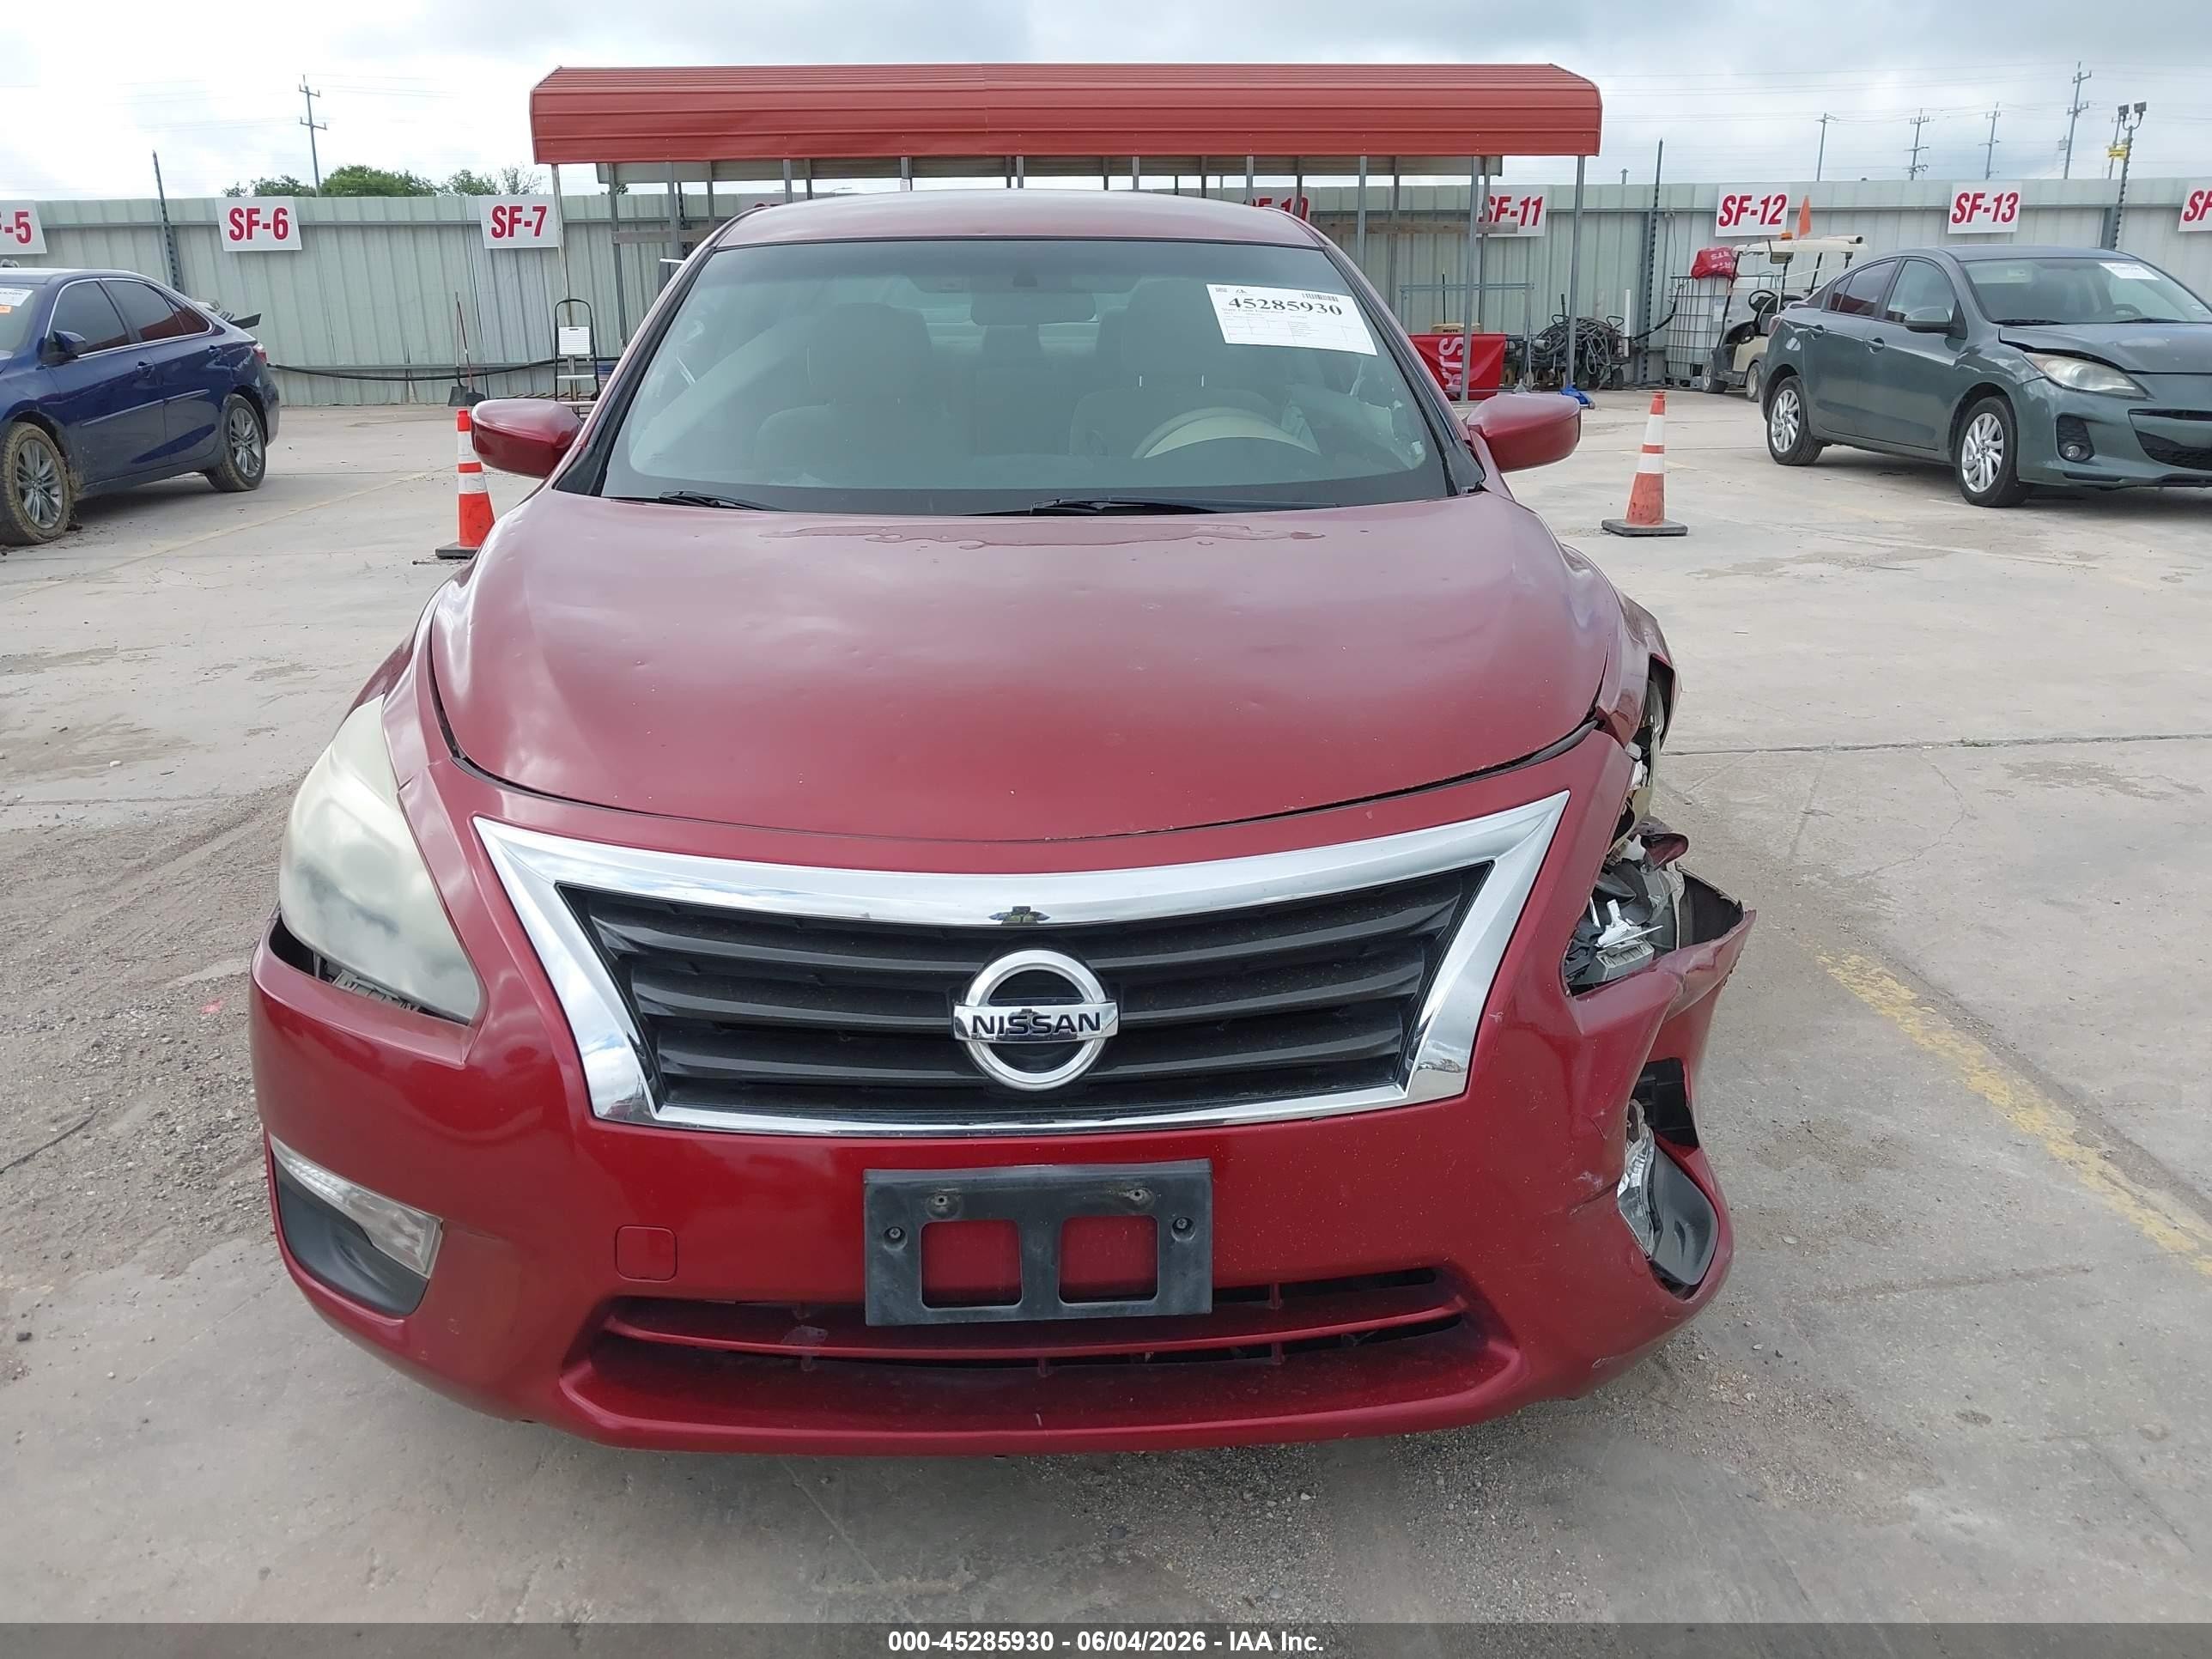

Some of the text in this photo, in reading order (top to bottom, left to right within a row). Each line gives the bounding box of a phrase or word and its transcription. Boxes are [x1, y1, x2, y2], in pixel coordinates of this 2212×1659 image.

[491, 205, 547, 239] SF-7
[1717, 194, 1788, 228] SF-12
[1951, 191, 2019, 224] SF-13
[0, 210, 32, 245] -5
[228, 208, 289, 241] SF-6
[1228, 297, 1343, 316] 45285930
[972, 1012, 1101, 1035] NISSAN
